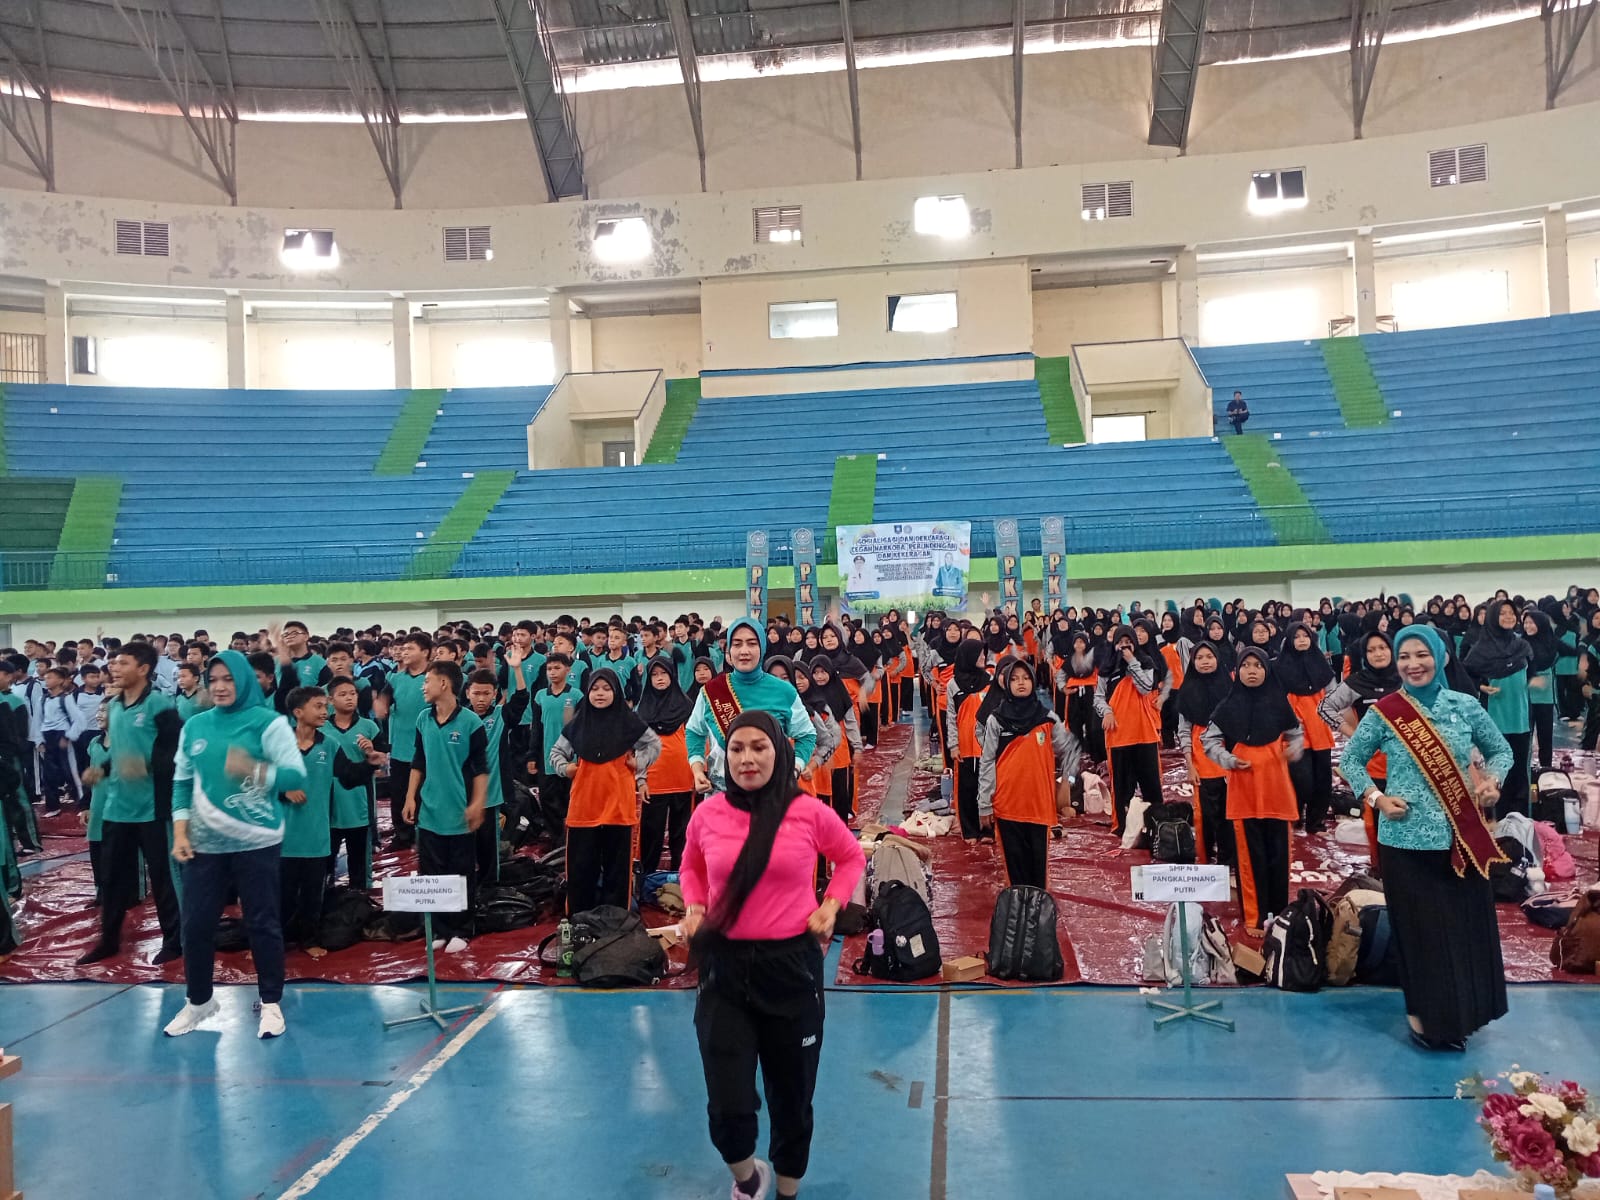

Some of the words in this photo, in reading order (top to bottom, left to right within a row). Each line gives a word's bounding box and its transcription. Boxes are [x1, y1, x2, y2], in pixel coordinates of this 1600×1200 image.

[799, 562, 815, 626] PKK
[1394, 716, 1413, 740] KOTA
[1410, 739, 1442, 780] PANGKAL
[1440, 780, 1462, 816] PINANG
[1408, 718, 1434, 748] BUNDA
[1429, 746, 1455, 777] FORUM
[1447, 777, 1465, 802] ANAK
